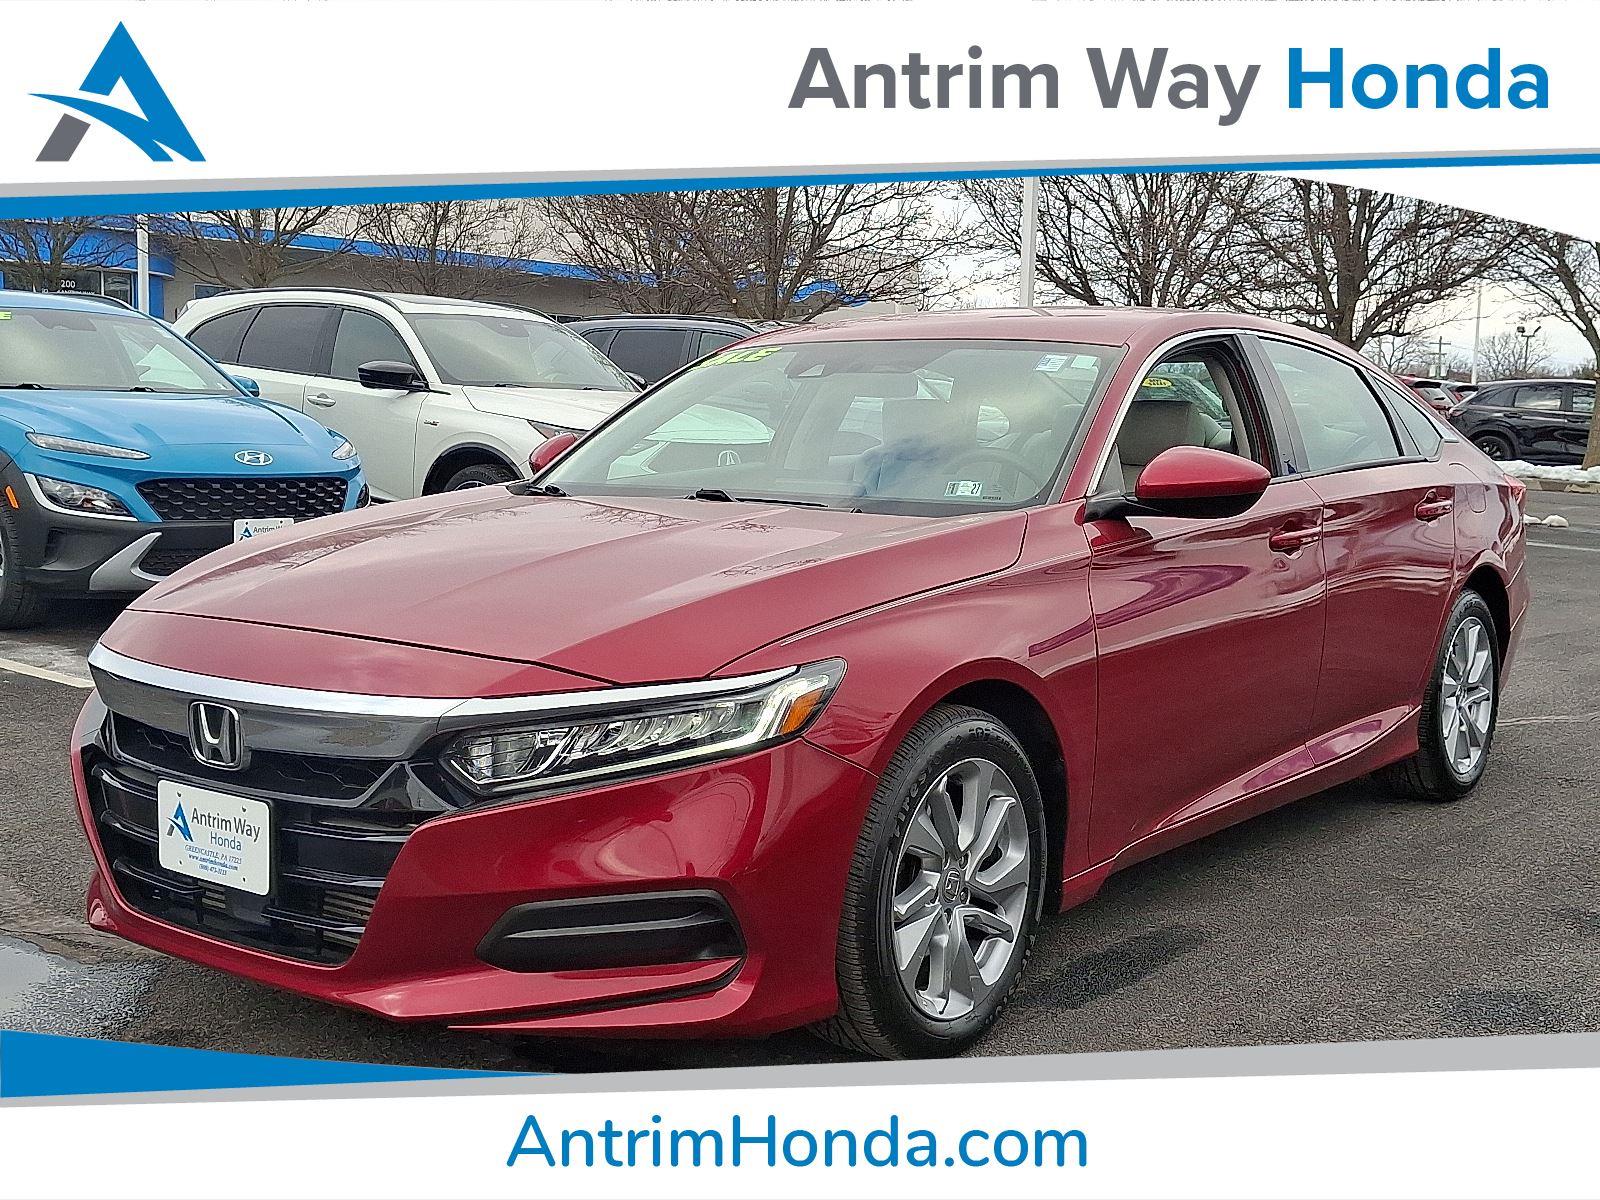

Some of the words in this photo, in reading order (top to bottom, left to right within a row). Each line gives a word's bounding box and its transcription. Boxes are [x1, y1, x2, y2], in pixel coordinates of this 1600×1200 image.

[60, 280, 76, 289] 200
[971, 483, 981, 495] 27
[191, 807, 232, 832] Antrim
[233, 817, 261, 843] Way
[210, 831, 242, 851] Honda
